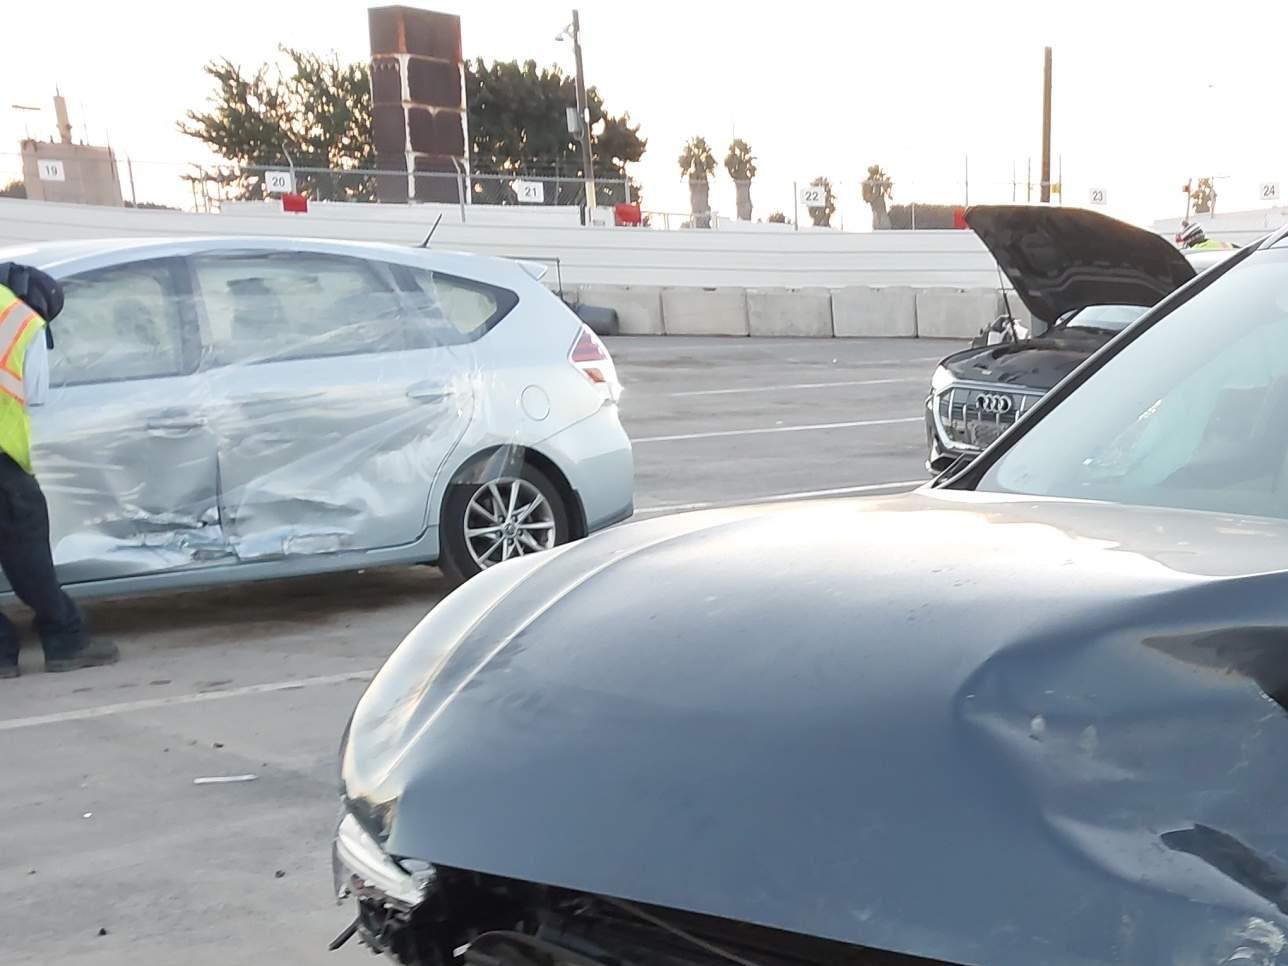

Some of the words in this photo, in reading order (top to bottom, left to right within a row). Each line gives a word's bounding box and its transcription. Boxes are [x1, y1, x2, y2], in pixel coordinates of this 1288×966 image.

[45, 165, 59, 176] 19
[271, 176, 286, 188] 20
[524, 186, 538, 198] 21
[804, 191, 820, 202] 22
[1092, 190, 1104, 202] 23
[1263, 185, 1276, 197] 24
